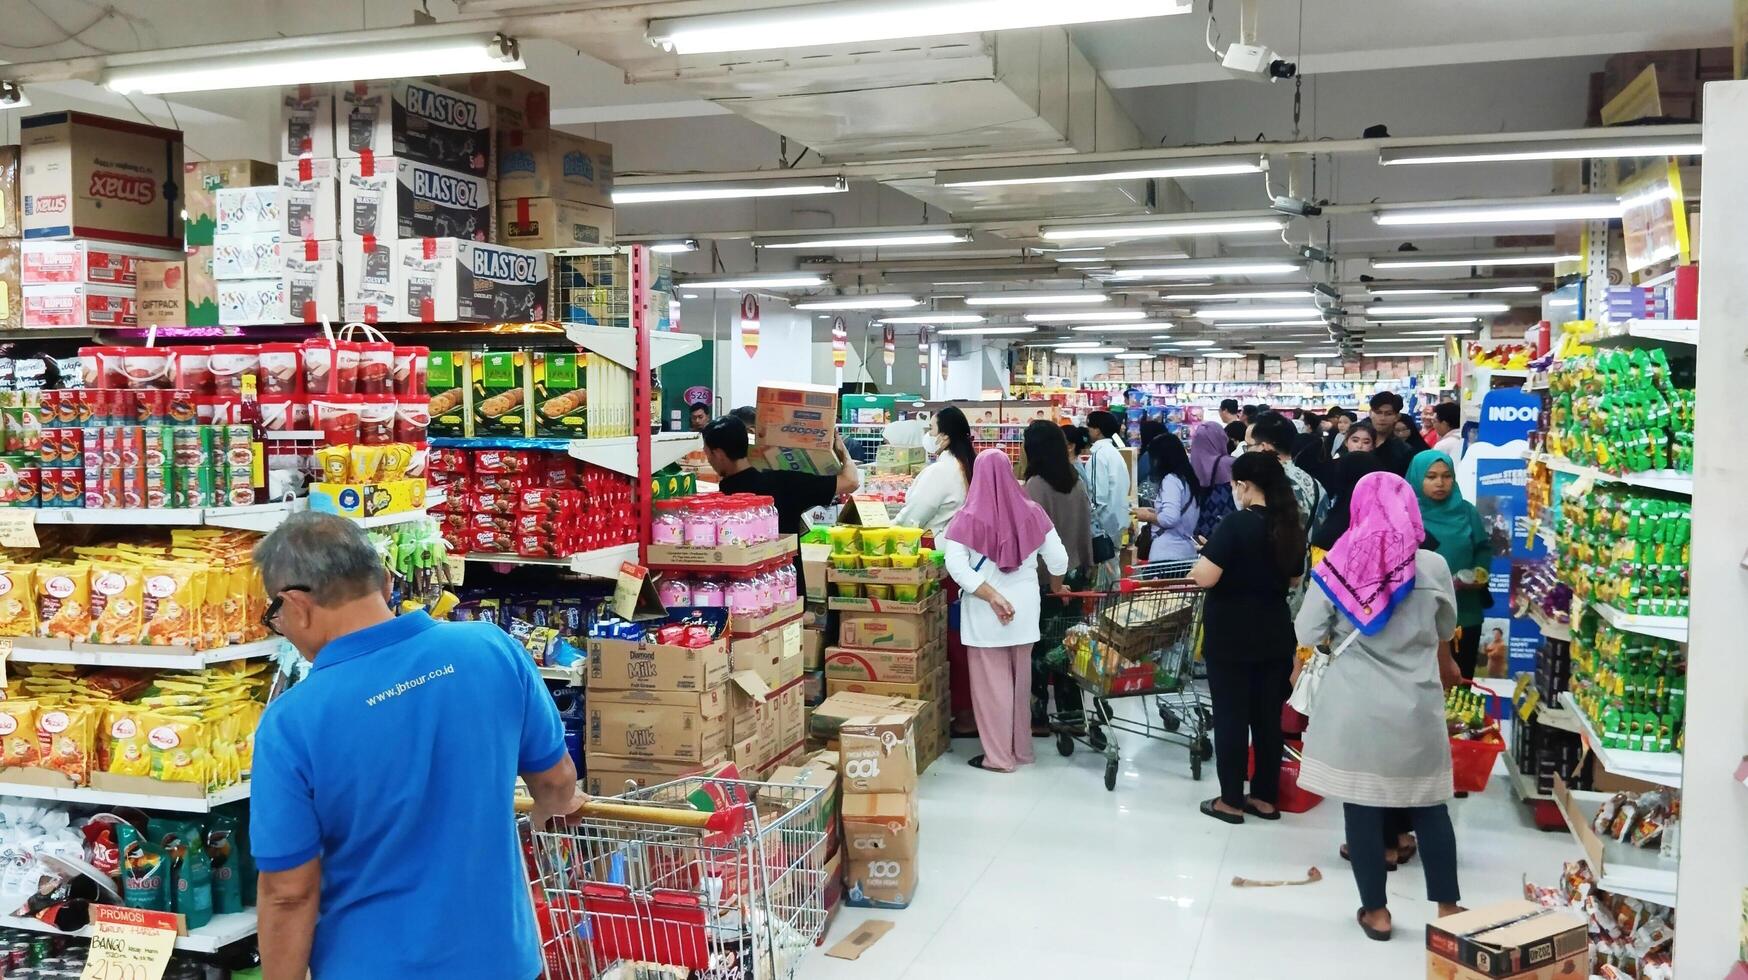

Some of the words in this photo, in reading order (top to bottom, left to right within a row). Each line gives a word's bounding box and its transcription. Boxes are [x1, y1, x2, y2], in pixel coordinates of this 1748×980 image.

[407, 85, 477, 130] BLASTOZ
[414, 168, 478, 209] BLASTOZ
[473, 248, 536, 284] BLASTOZ
[143, 300, 179, 310] GIFTPACK
[529, 309, 535, 322] 5
[630, 650, 655, 660] Diamond
[628, 661, 657, 679] Milk
[366, 664, 455, 706] www.jbtour.co.id
[626, 729, 656, 747] Milk
[846, 758, 880, 778] 100
[853, 838, 887, 849] 100
[867, 861, 901, 878] 100
[100, 908, 145, 924] PROMOSI
[92, 935, 126, 953] BANGO
